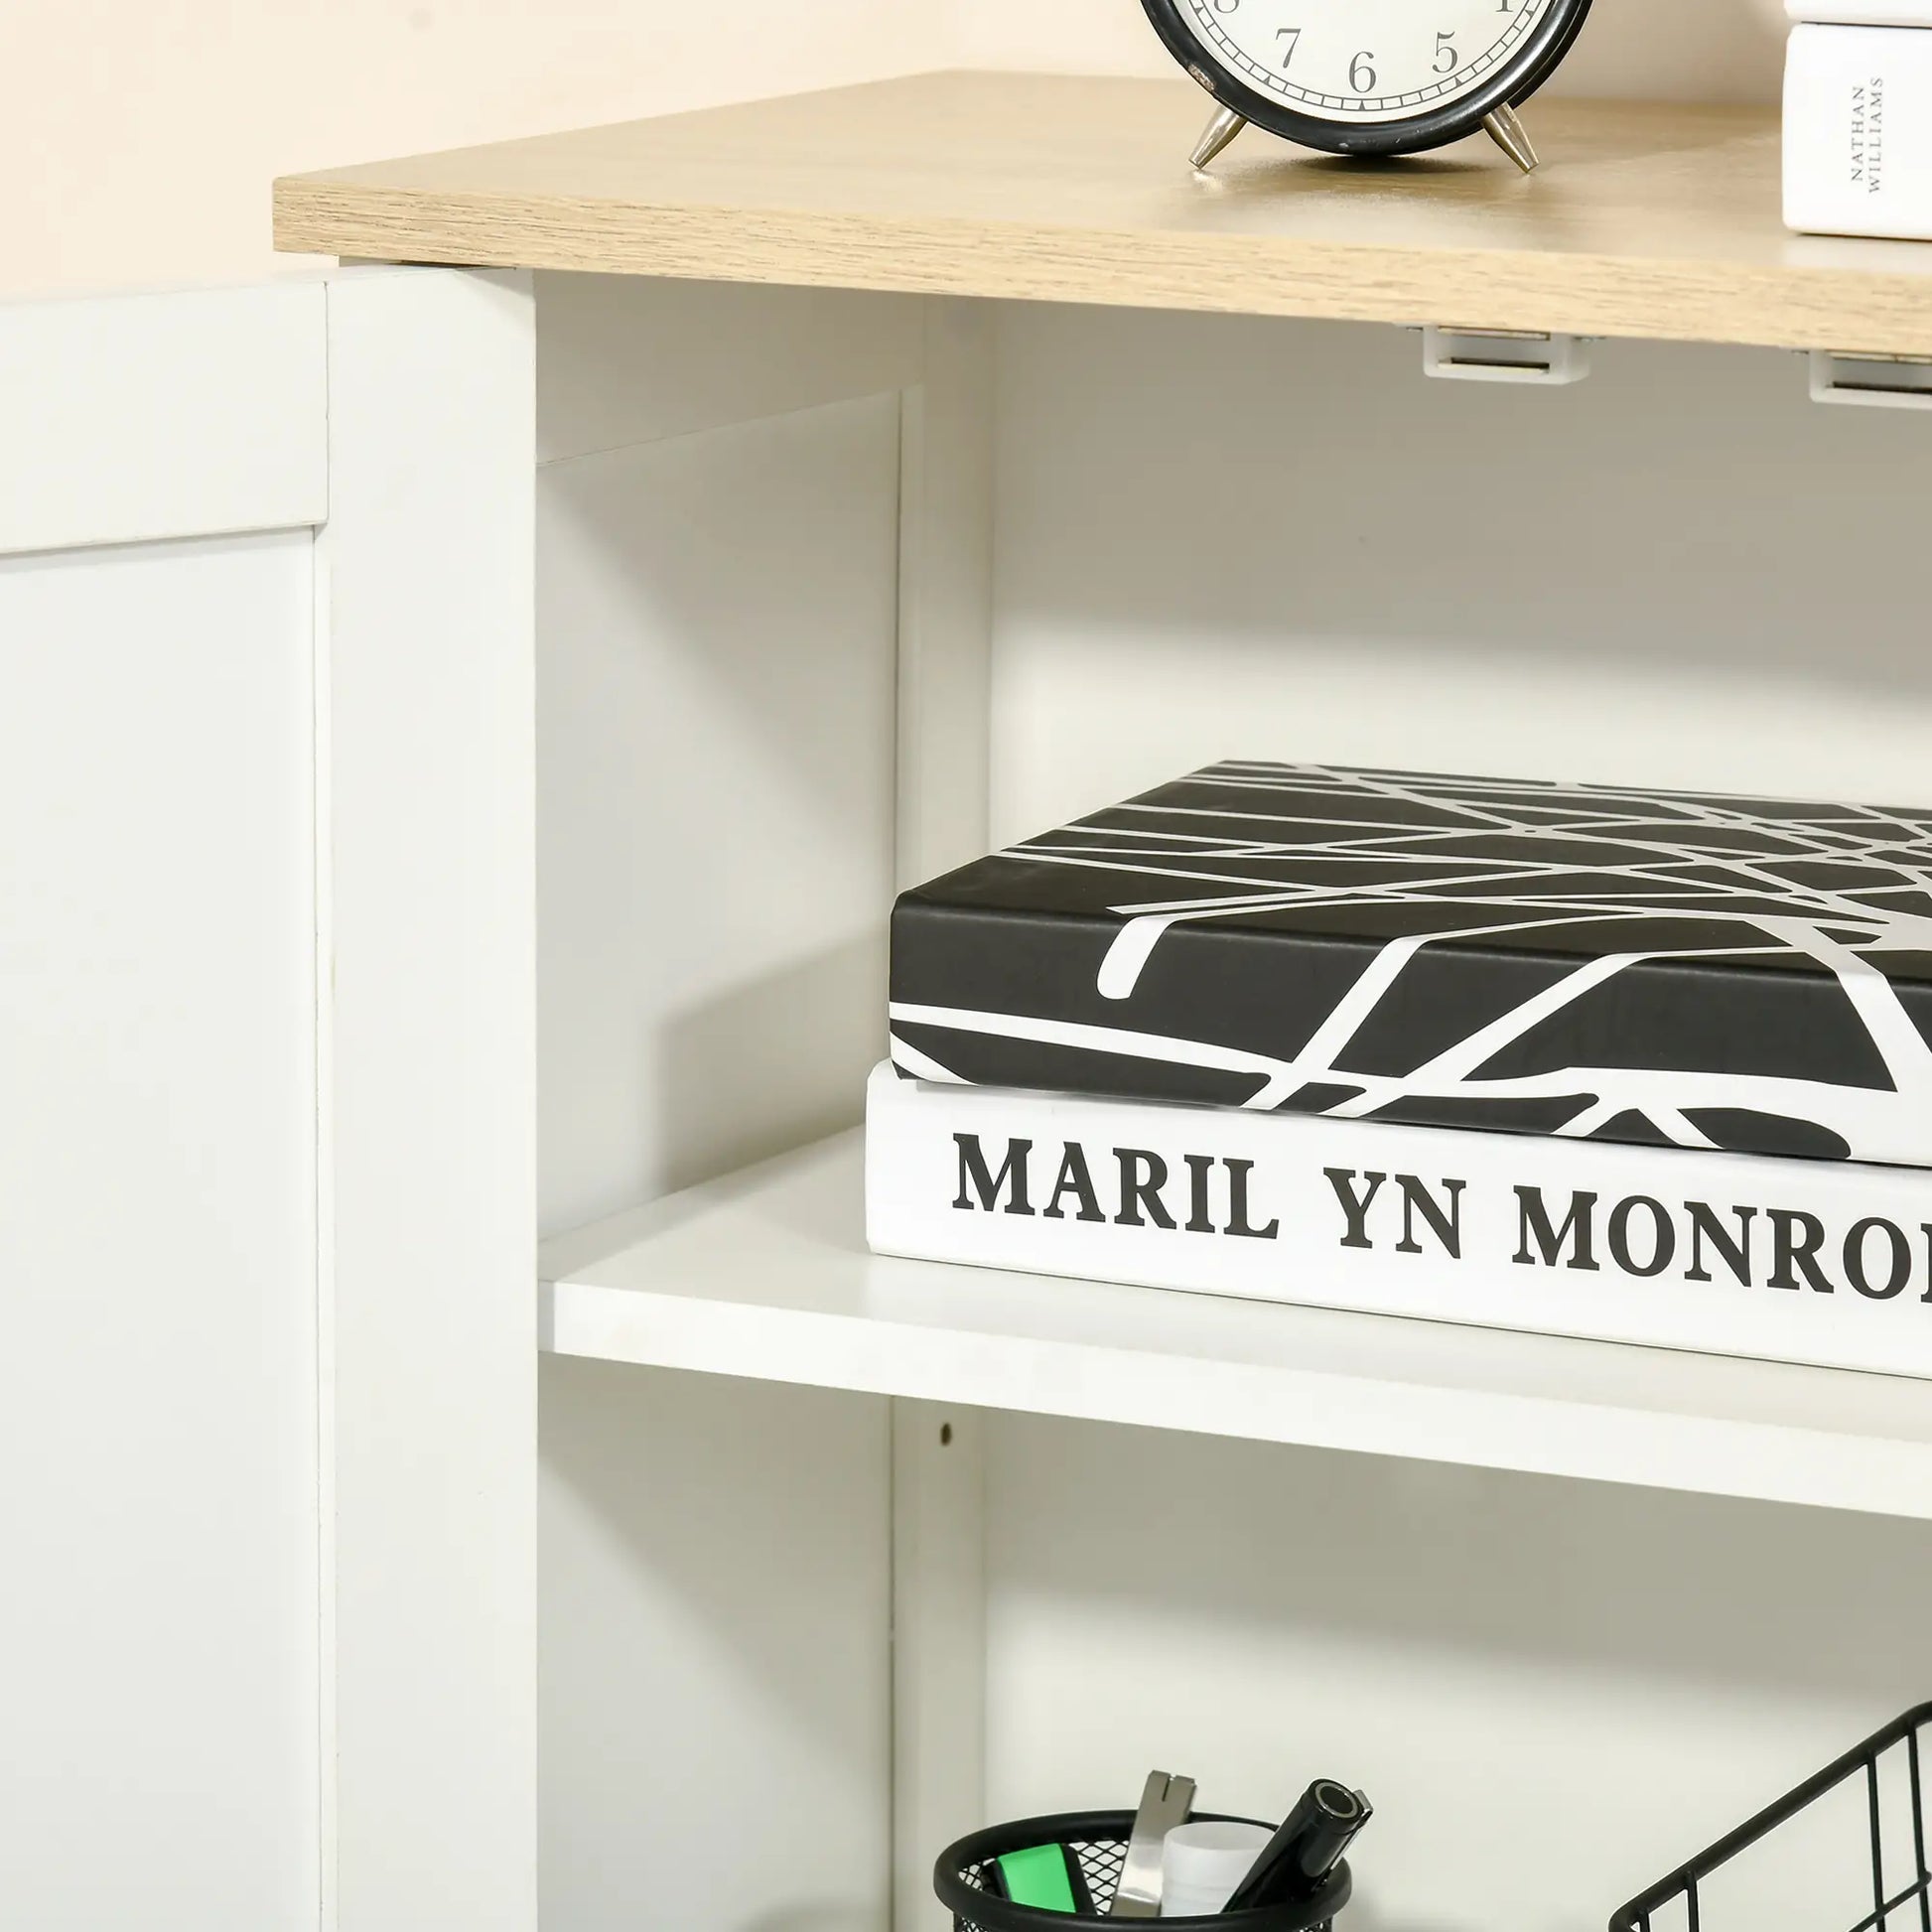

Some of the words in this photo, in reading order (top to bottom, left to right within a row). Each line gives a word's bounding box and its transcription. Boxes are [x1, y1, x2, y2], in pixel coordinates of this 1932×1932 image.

[1275, 28, 1302, 69] 7
[1432, 31, 1458, 73] 5
[1348, 52, 1377, 93] 6
[1851, 86, 1864, 182] NATHAN
[1868, 77, 1883, 194] WILLIAMS
